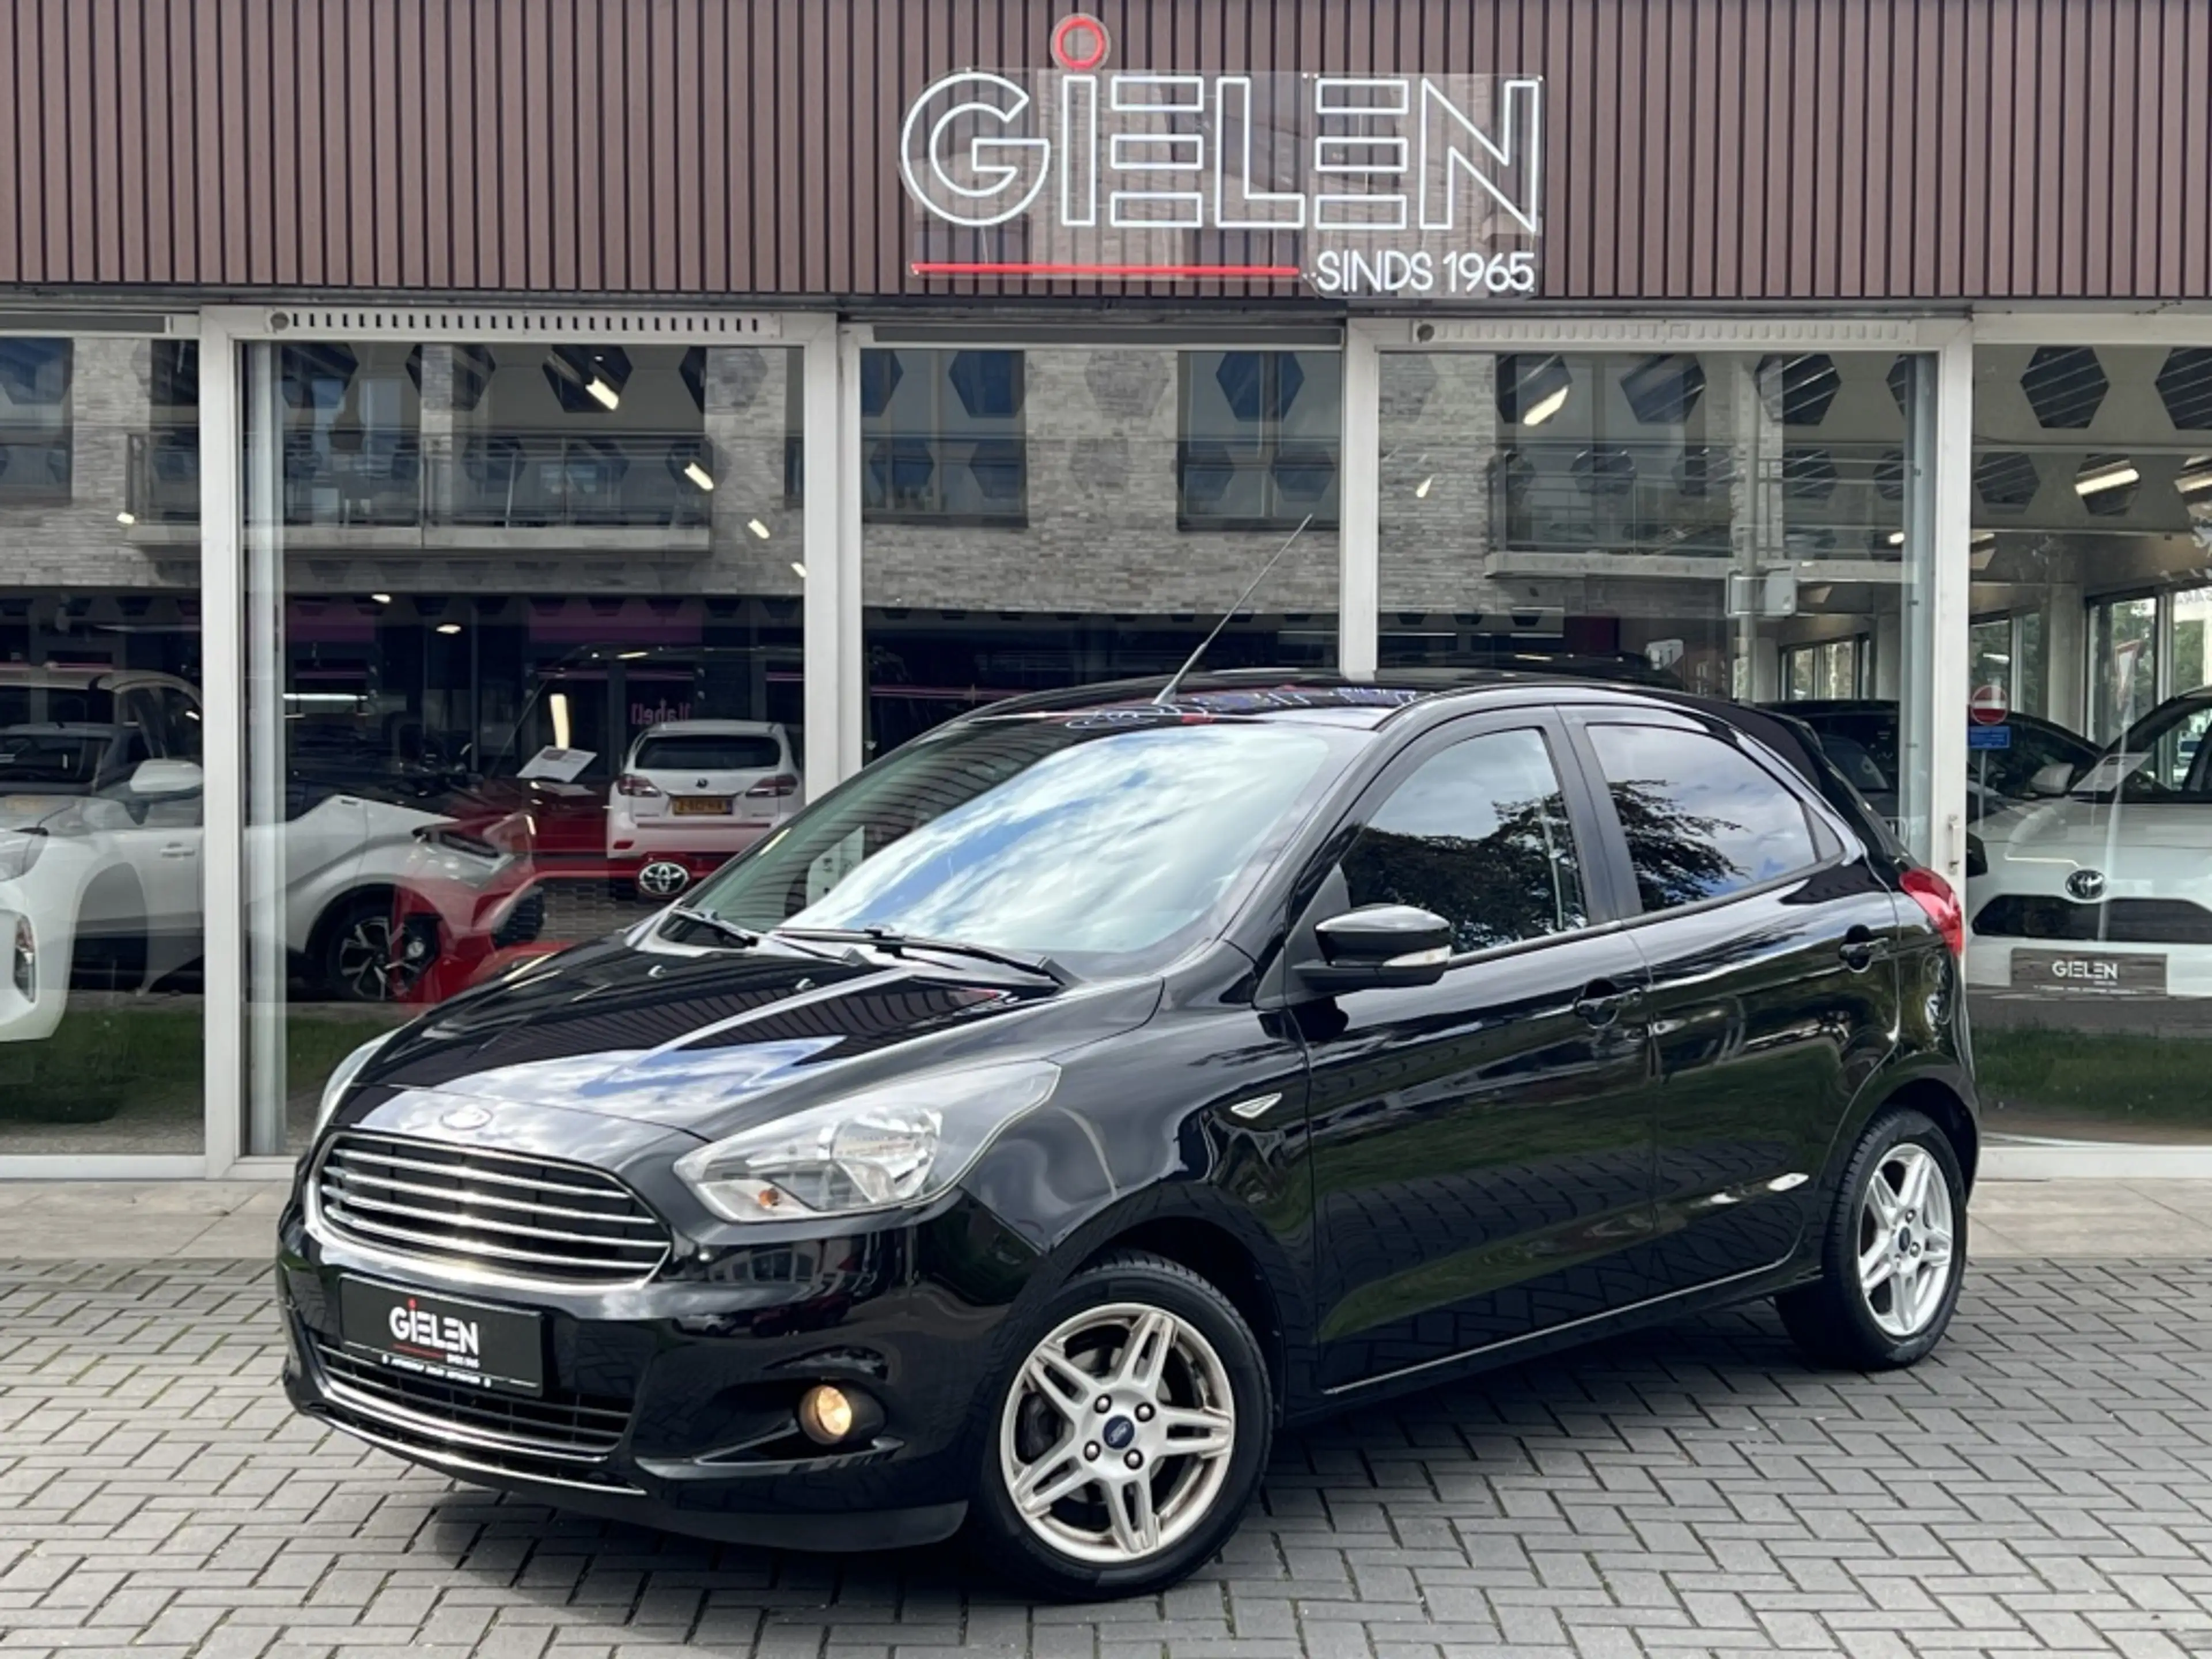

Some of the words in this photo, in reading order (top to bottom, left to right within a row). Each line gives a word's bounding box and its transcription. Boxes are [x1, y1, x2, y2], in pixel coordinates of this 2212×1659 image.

[1317, 251, 1432, 293] SINDS
[1444, 251, 1535, 293] 1965
[2052, 960, 2118, 979] GIELEN
[389, 1298, 479, 1355] GIELEN
